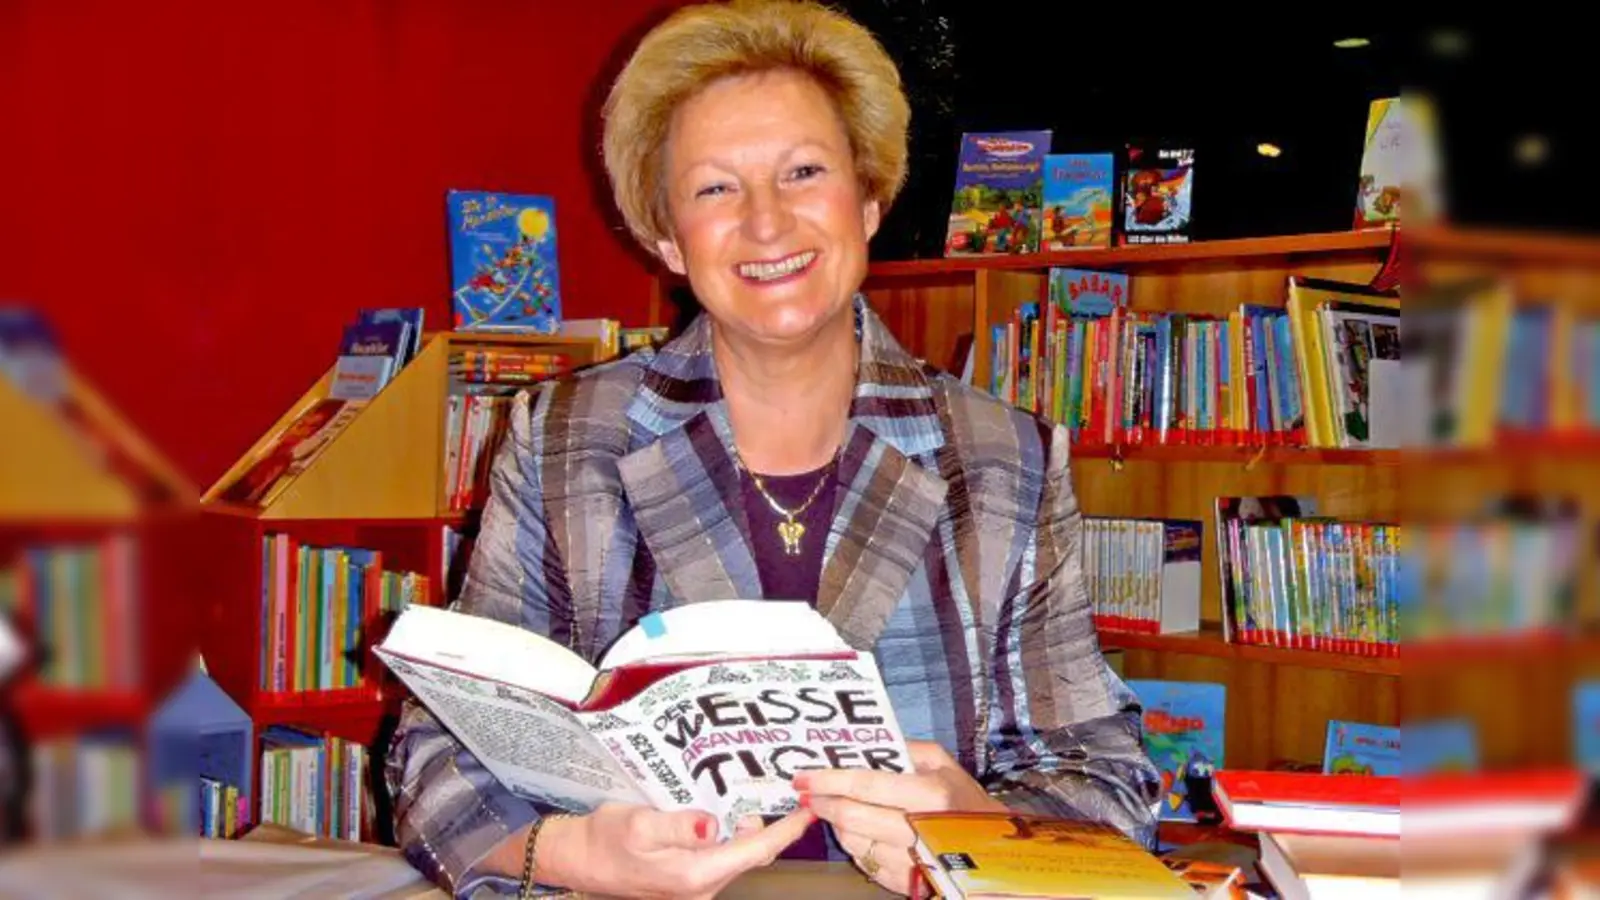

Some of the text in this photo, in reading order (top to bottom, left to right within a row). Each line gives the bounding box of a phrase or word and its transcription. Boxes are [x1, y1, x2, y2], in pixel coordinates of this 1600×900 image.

[1068, 273, 1122, 303] BABAR
[653, 699, 694, 732] DER
[681, 727, 792, 768] ARAVIND
[805, 727, 894, 743] ADIGA
[691, 745, 904, 797] TIGER
